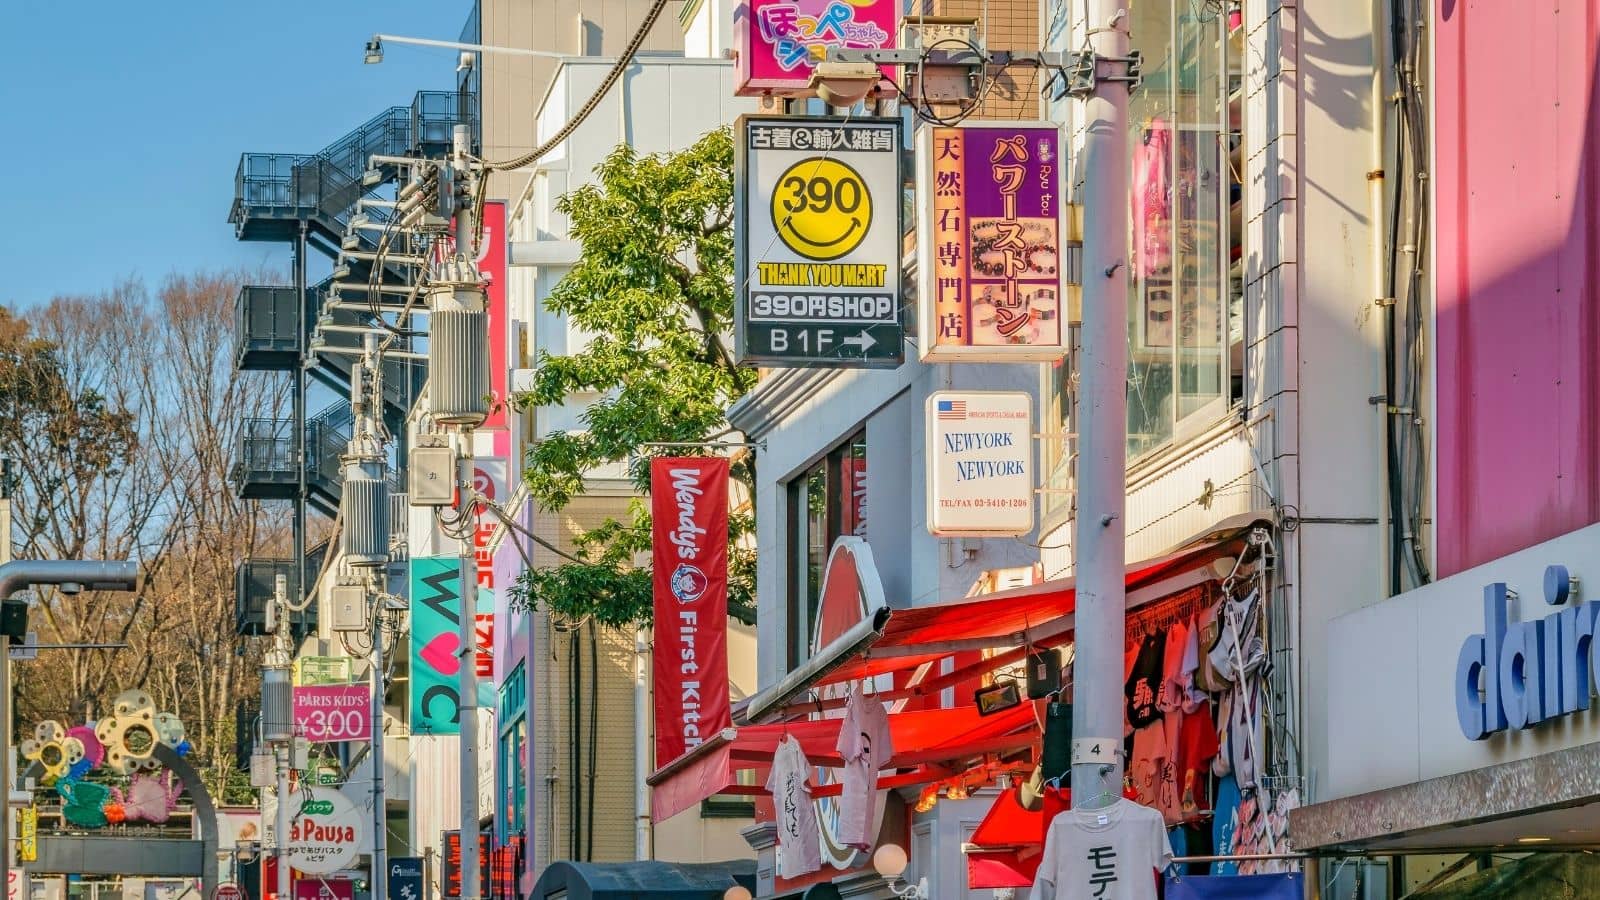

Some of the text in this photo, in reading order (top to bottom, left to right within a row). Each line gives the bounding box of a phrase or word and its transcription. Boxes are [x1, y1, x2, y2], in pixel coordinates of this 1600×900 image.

[761, 4, 886, 40] ほっぺちゃん
[778, 40, 875, 66] ショ
[751, 127, 892, 150] 古着&輸入雑貨
[1039, 165, 1052, 189] Ryu
[783, 176, 862, 214] 390
[1041, 193, 1053, 216] tou
[935, 135, 963, 339] 天然石専門店
[990, 134, 1030, 338] パワーストーン
[758, 262, 887, 287] THANK YOU MART
[754, 295, 892, 318] 390円SHOP
[669, 468, 706, 560] Wendy's
[679, 611, 701, 674] First
[298, 692, 364, 707] PARIS KID'S
[298, 710, 364, 736] ¥300
[1090, 743, 1101, 755] 4
[303, 818, 355, 844] Pausa
[1087, 846, 1118, 899] モテ
